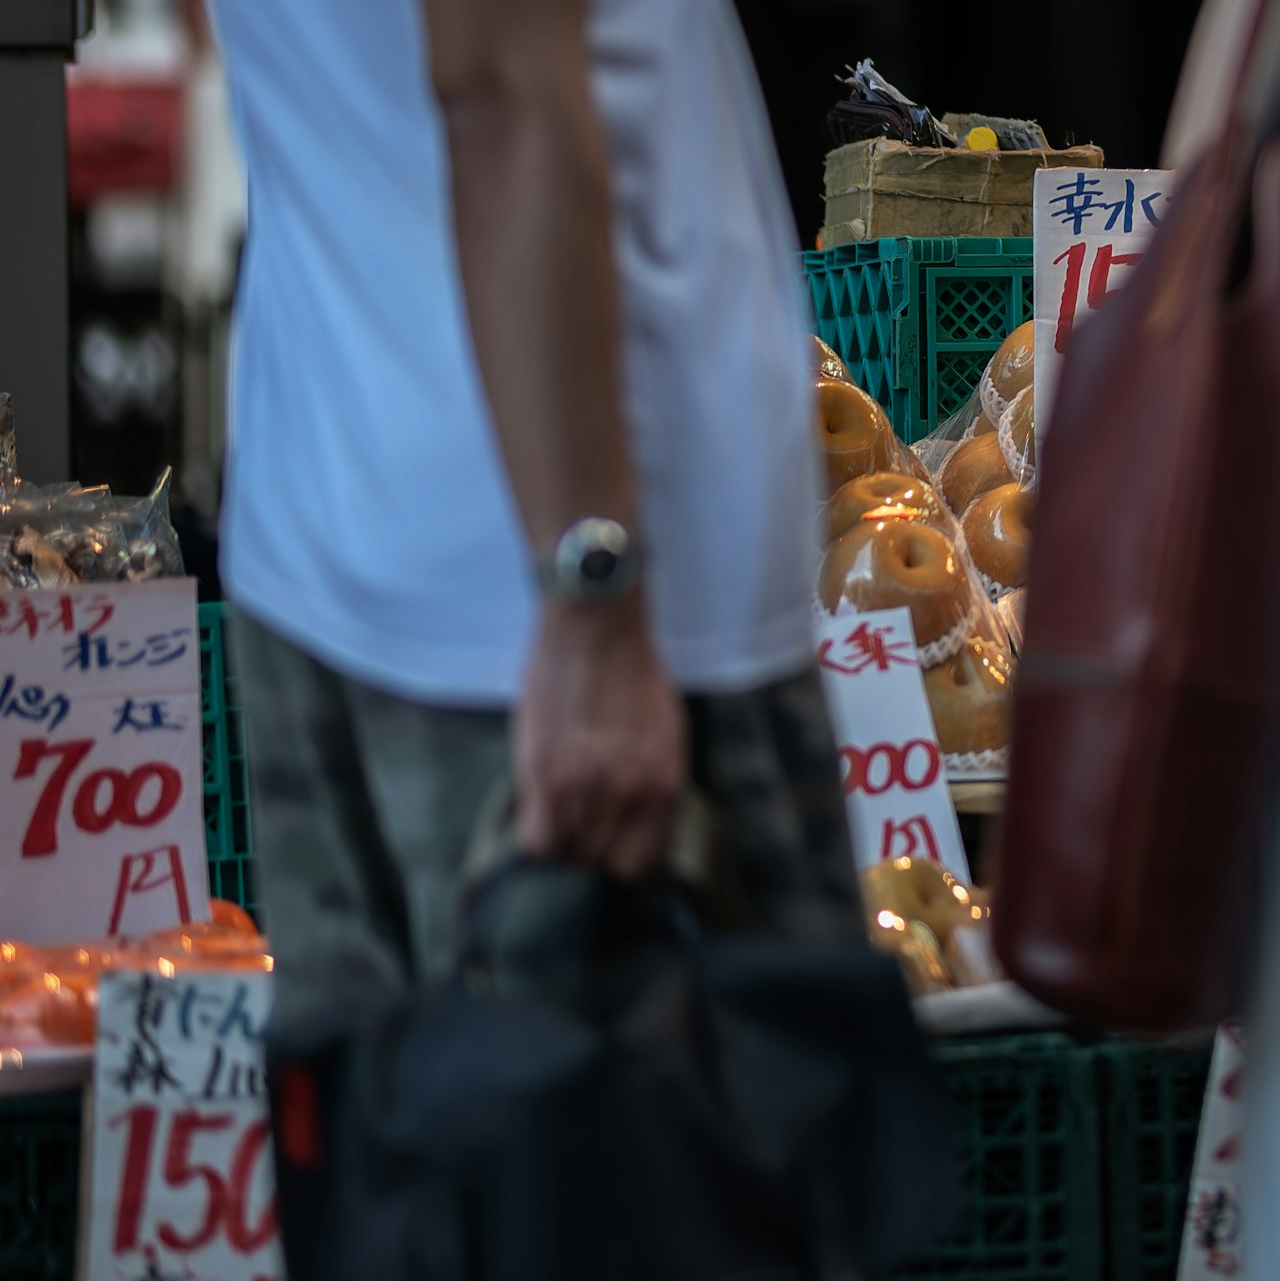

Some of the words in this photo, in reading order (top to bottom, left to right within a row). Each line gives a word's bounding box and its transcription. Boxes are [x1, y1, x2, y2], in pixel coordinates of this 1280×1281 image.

[1049, 172, 1172, 235] 幸水
[61, 627, 191, 672] オレンジ
[13, 736, 184, 858] 700
[108, 844, 192, 942] 円
